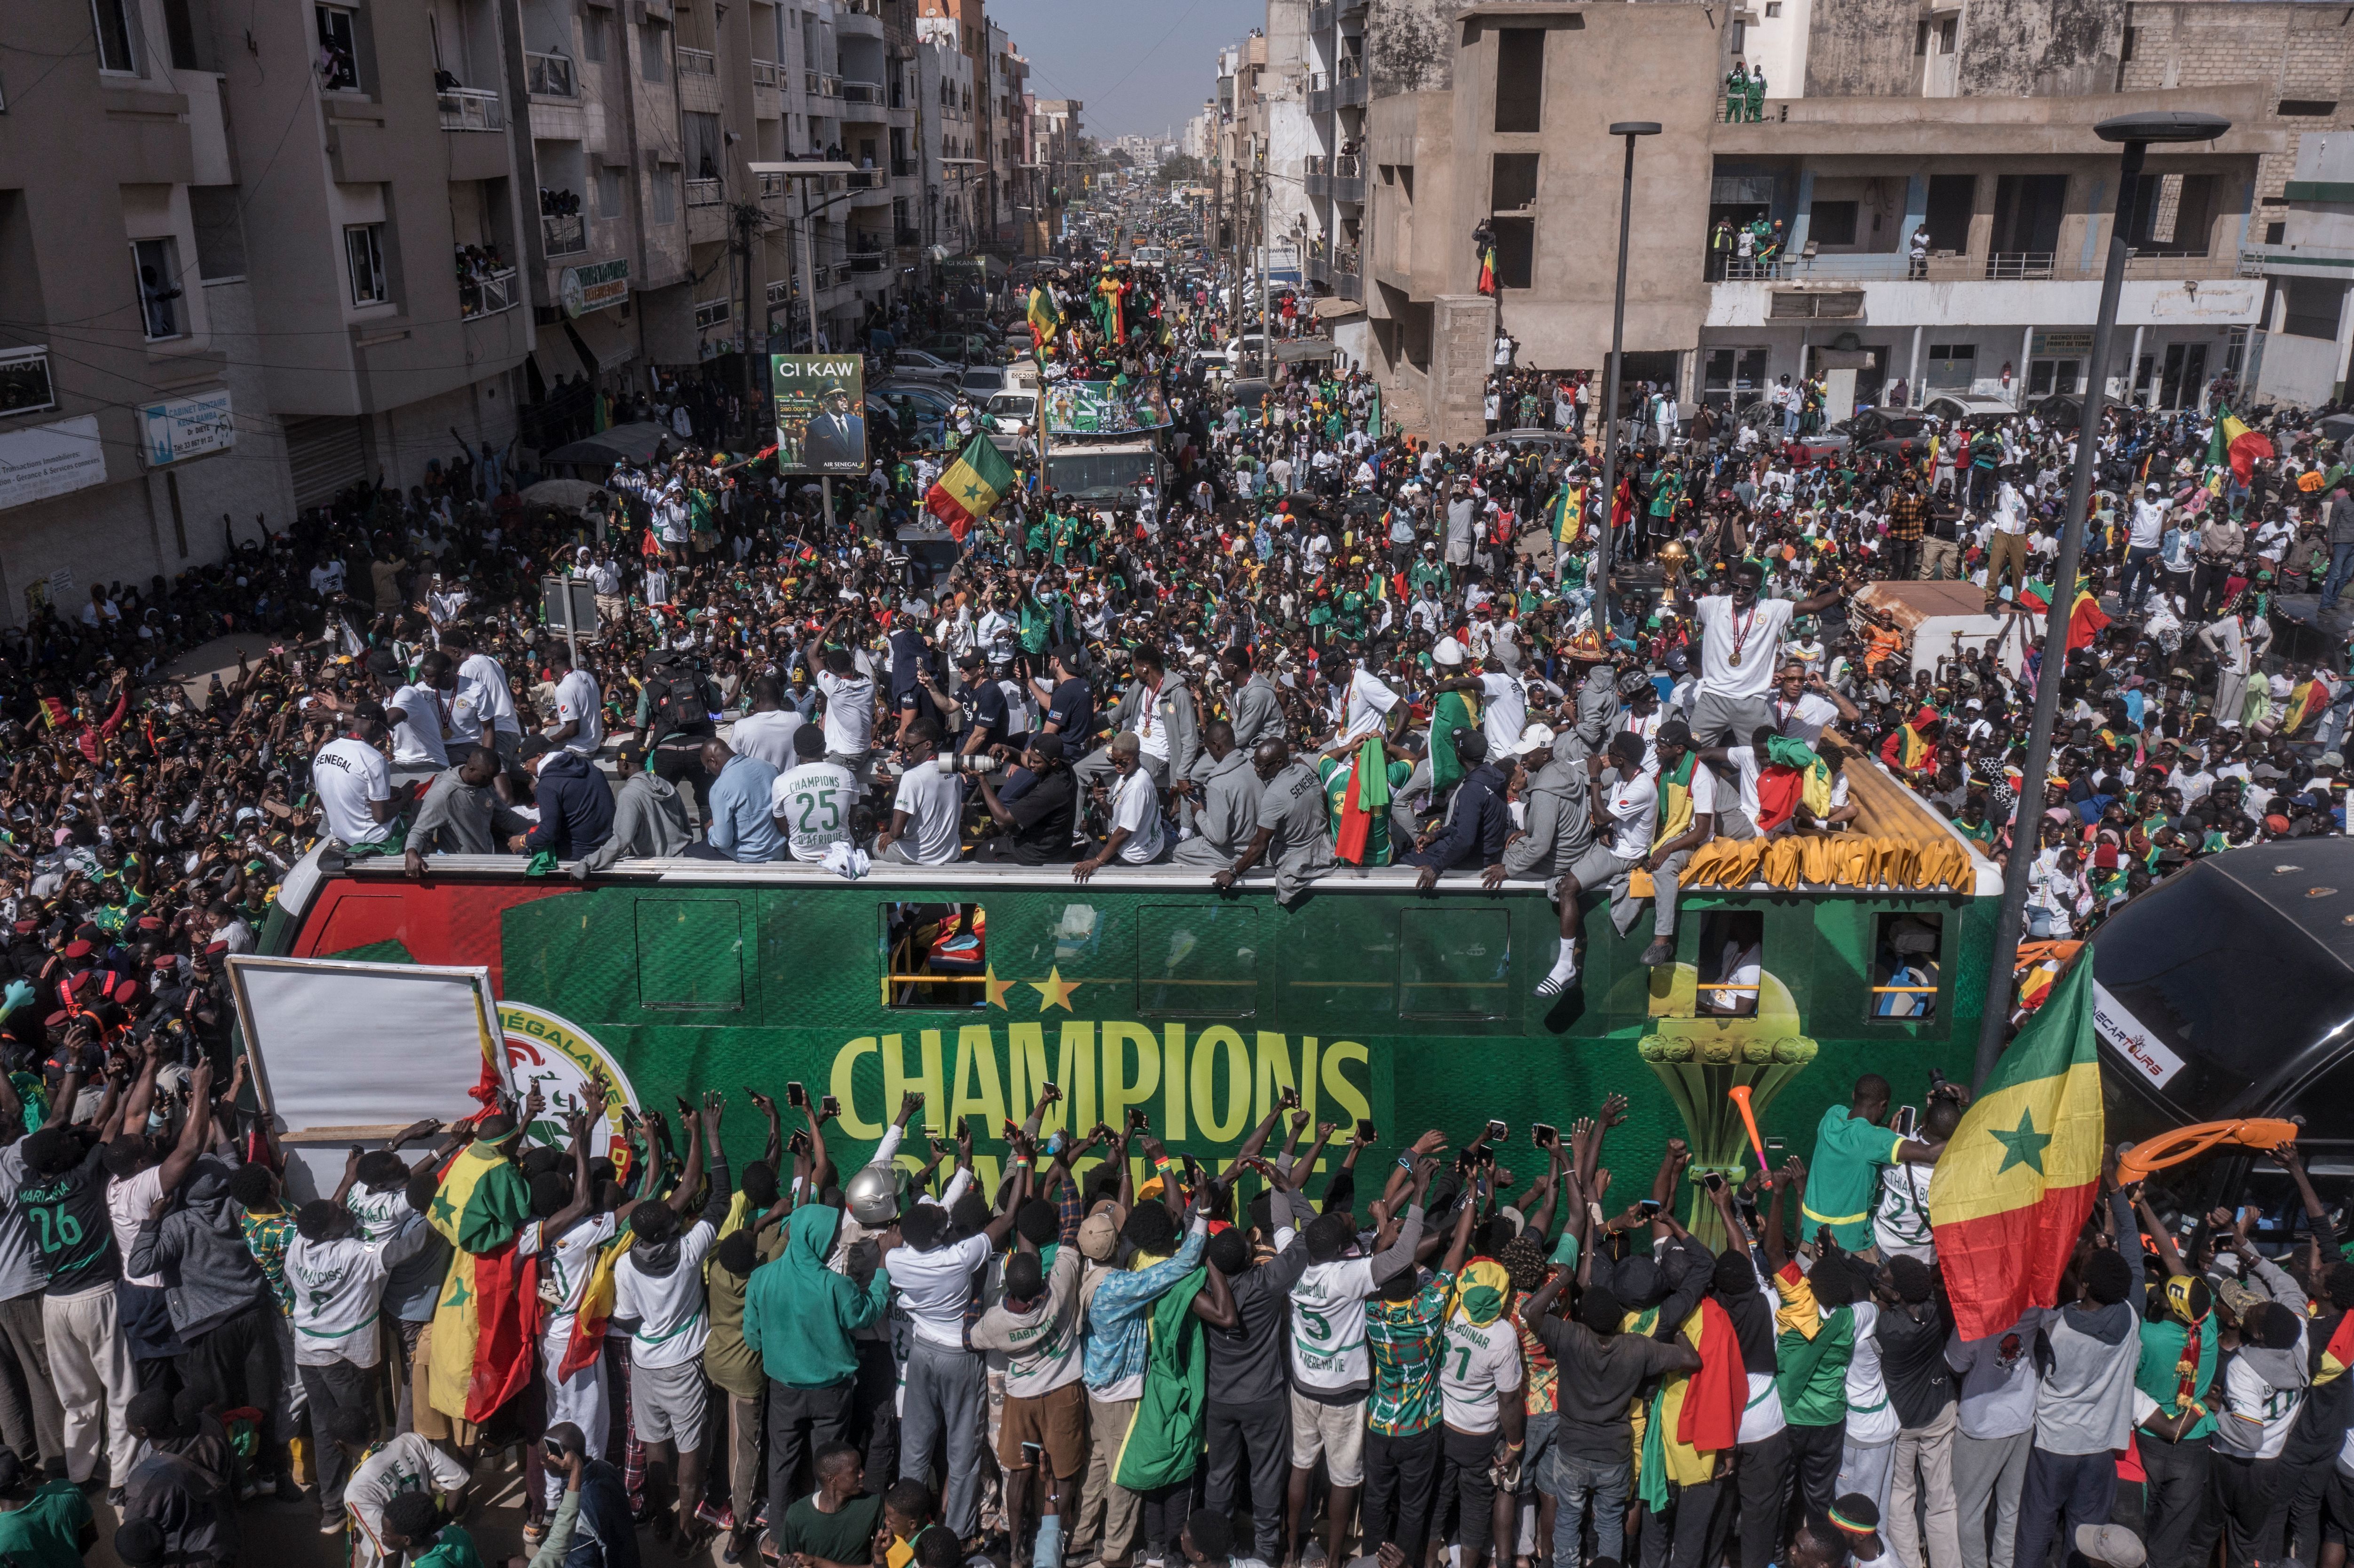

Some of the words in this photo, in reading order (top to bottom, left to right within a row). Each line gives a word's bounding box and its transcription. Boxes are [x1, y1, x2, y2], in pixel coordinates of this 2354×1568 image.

[779, 362, 800, 377] CI
[808, 362, 853, 377] KAW
[169, 405, 197, 417] CABINET
[198, 398, 226, 412] DENTAIRE
[177, 416, 196, 427] KEUR
[196, 411, 217, 425] BAMBA
[196, 425, 210, 433] DIEYE
[191, 439, 199, 448] 867
[201, 437, 206, 446] 91
[207, 435, 213, 444] 23
[2, 460, 42, 474] Transactions
[16, 471, 42, 482] Gérance
[49, 465, 69, 474] Services
[70, 458, 100, 470] connexes
[316, 754, 350, 773] SENEGAL
[790, 776, 840, 794] CHAMPIONS
[1290, 771, 1319, 799] SENEGA
[796, 789, 839, 833] 25
[798, 831, 843, 846] D'AFRIQUE
[830, 1021, 1371, 1146] CHAMPIONS
[29, 1203, 82, 1253] 26
[318, 1268, 343, 1284] CISS
[1009, 1329, 1038, 1343] BABA
[1455, 1324, 1490, 1349] GUINAR
[1303, 1352, 1321, 1370] MERE
[1322, 1359, 1333, 1372] MA
[1335, 1358, 1345, 1372] VIE
